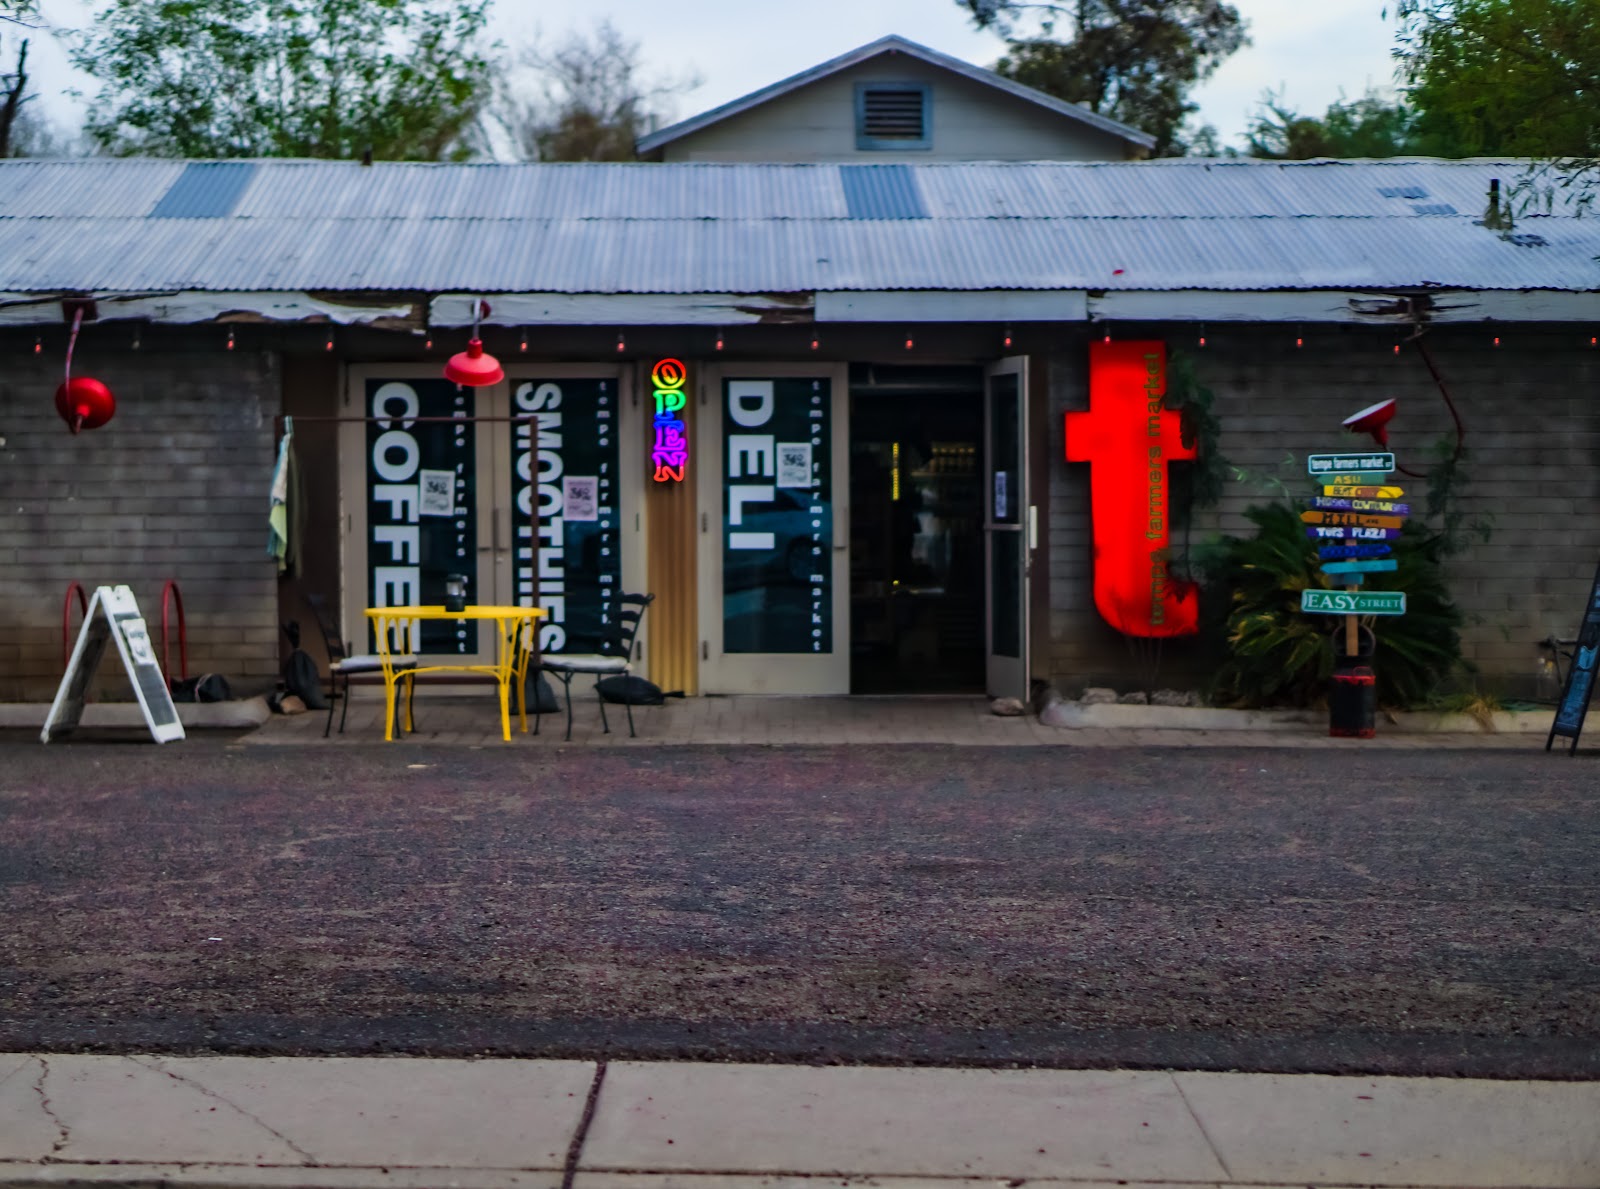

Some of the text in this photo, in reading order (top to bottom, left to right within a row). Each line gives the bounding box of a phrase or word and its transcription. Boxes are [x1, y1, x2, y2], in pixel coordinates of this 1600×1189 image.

[597, 381, 610, 447] tempe
[652, 358, 688, 482] OPEN
[1143, 353, 1161, 437] market
[728, 380, 775, 549] DELI
[1145, 446, 1163, 540] farmers
[1334, 476, 1360, 484] ASU
[1360, 455, 1384, 468] market
[373, 382, 421, 653] COFFEE
[455, 463, 468, 556] farmers
[516, 382, 566, 652] SMOOTHIES
[598, 463, 612, 557] farmers
[810, 380, 824, 651] tempe farmers market
[1322, 512, 1364, 527] MILL
[1309, 594, 1398, 609] EASY STREET
